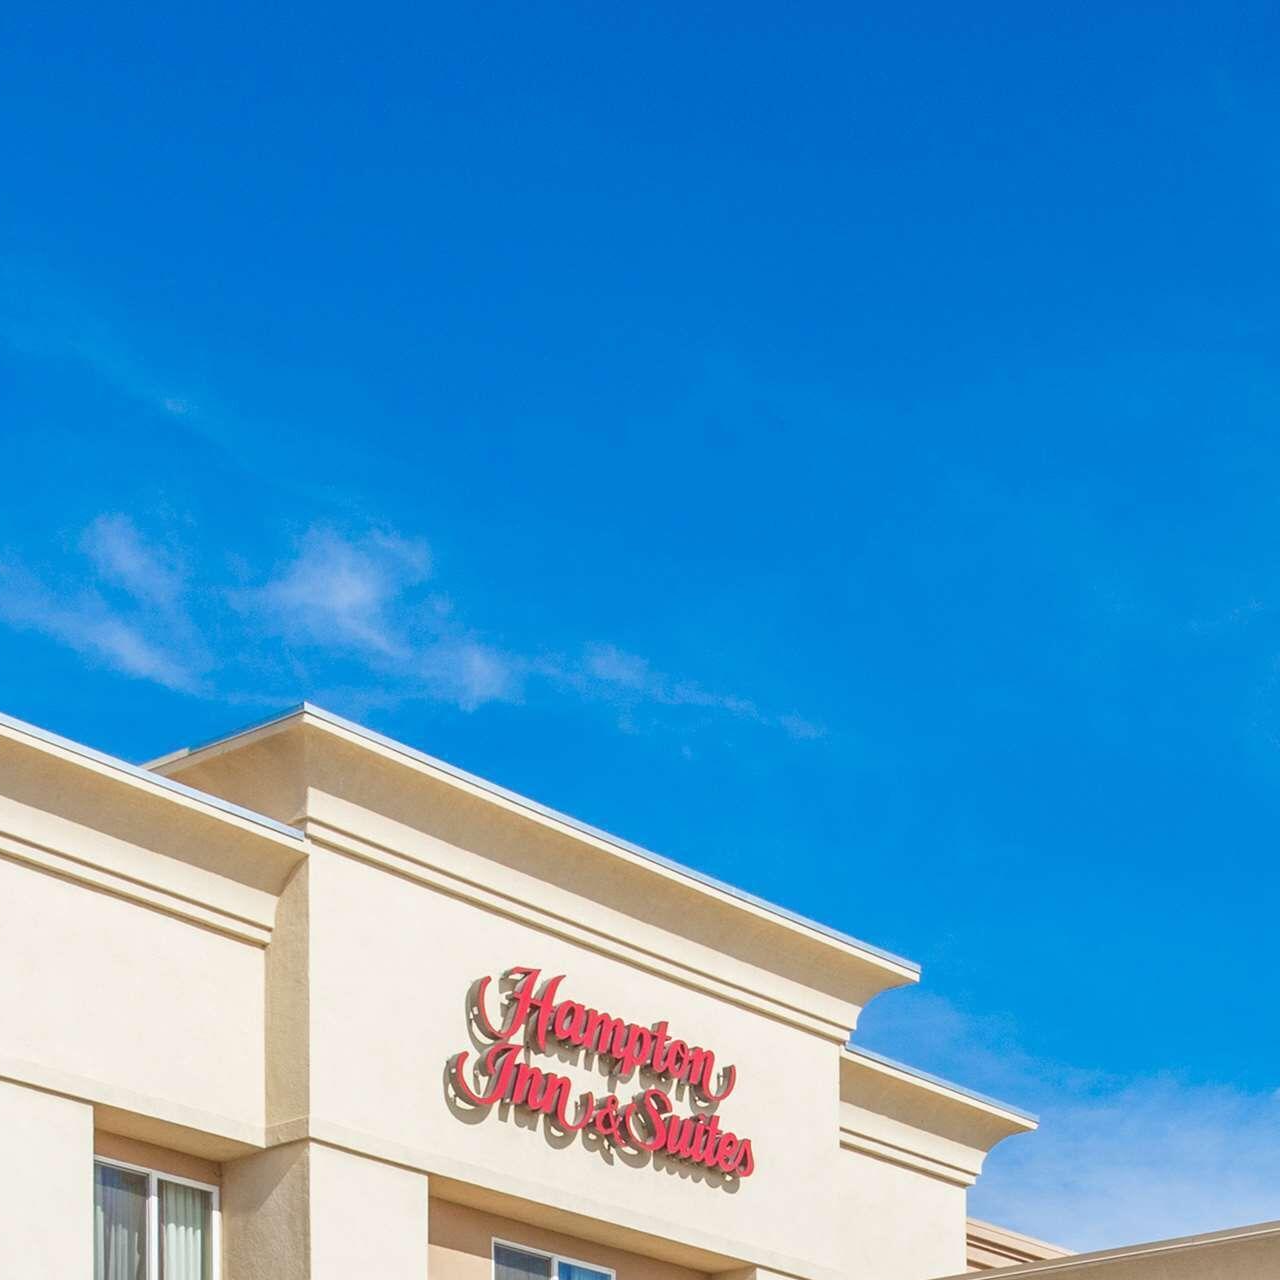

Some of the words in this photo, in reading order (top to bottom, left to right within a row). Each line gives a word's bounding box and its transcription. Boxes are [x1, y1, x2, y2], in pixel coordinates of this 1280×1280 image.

[465, 966, 736, 1101] Hampton
[446, 1042, 594, 1131] Inn
[594, 1093, 627, 1148] &
[624, 1088, 755, 1177] Suites
